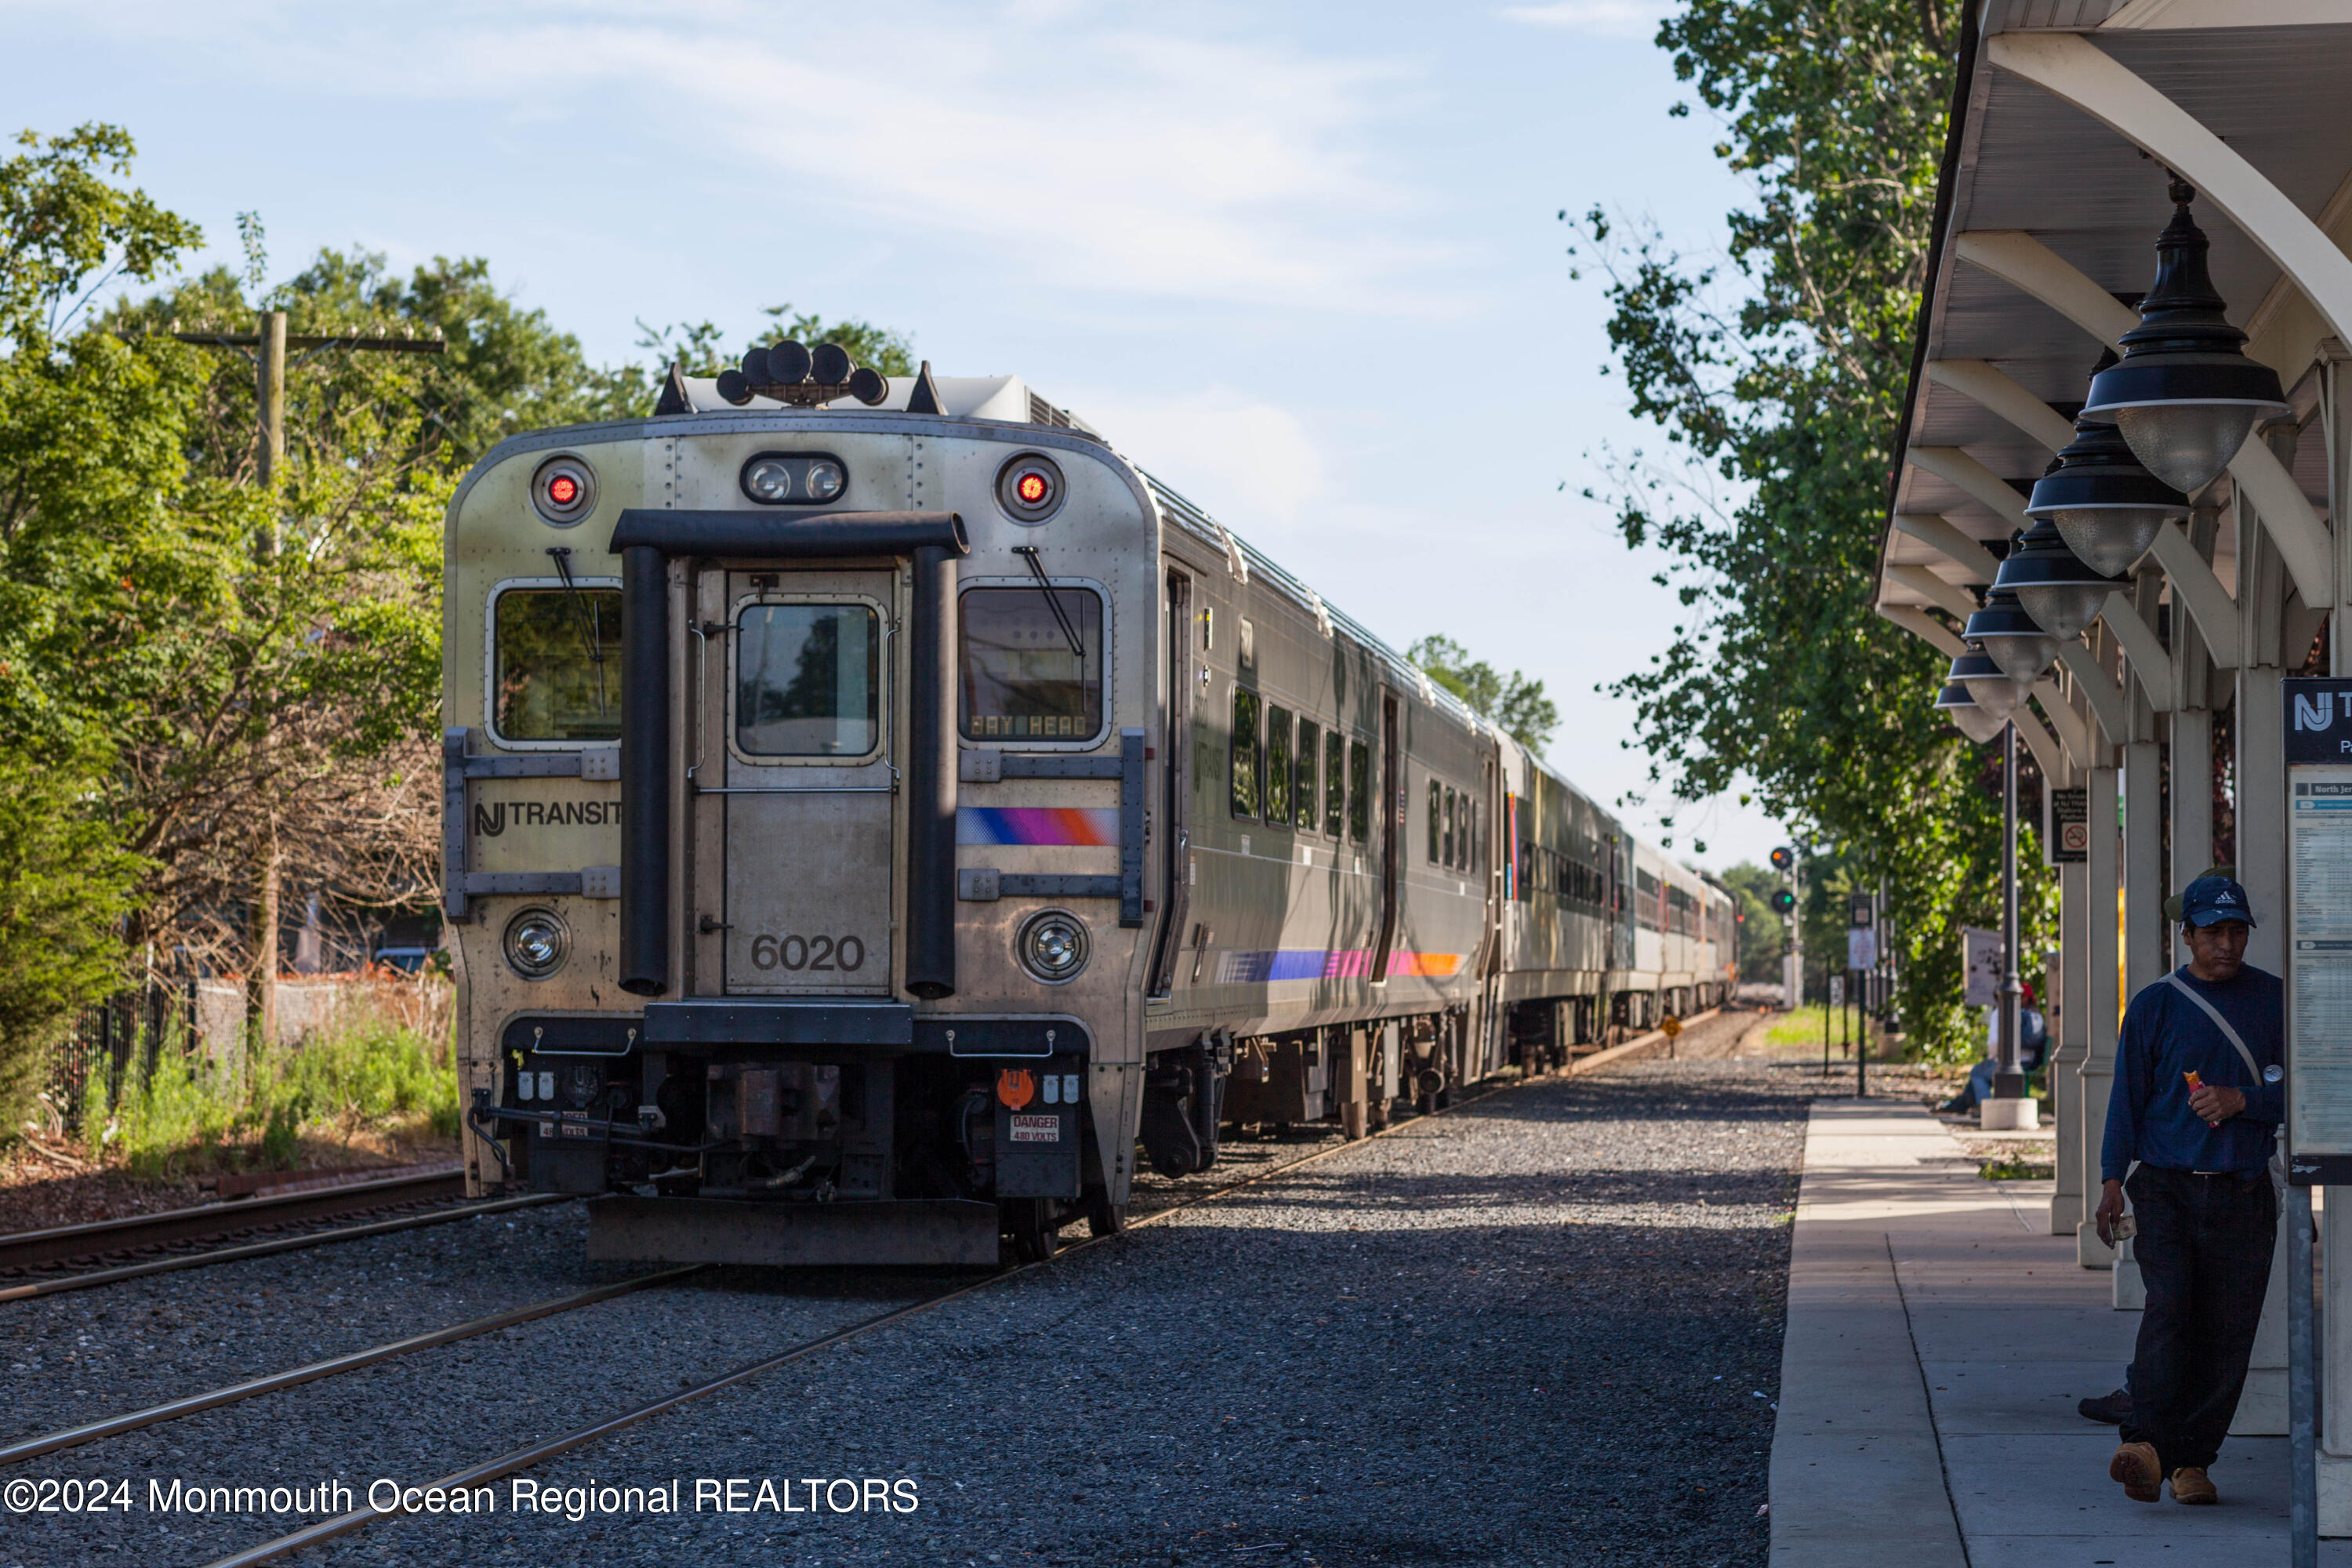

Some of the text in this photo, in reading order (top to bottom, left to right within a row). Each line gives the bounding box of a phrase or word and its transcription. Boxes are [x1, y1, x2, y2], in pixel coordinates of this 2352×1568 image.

[1030, 715, 1086, 735] HEAD
[2295, 692, 2333, 731] NJ
[474, 801, 622, 837] NJ TRANSIT
[751, 934, 865, 972] 6020
[1014, 1116, 1058, 1128] DANGER
[1014, 1132, 1057, 1142] 480 VOLTS
